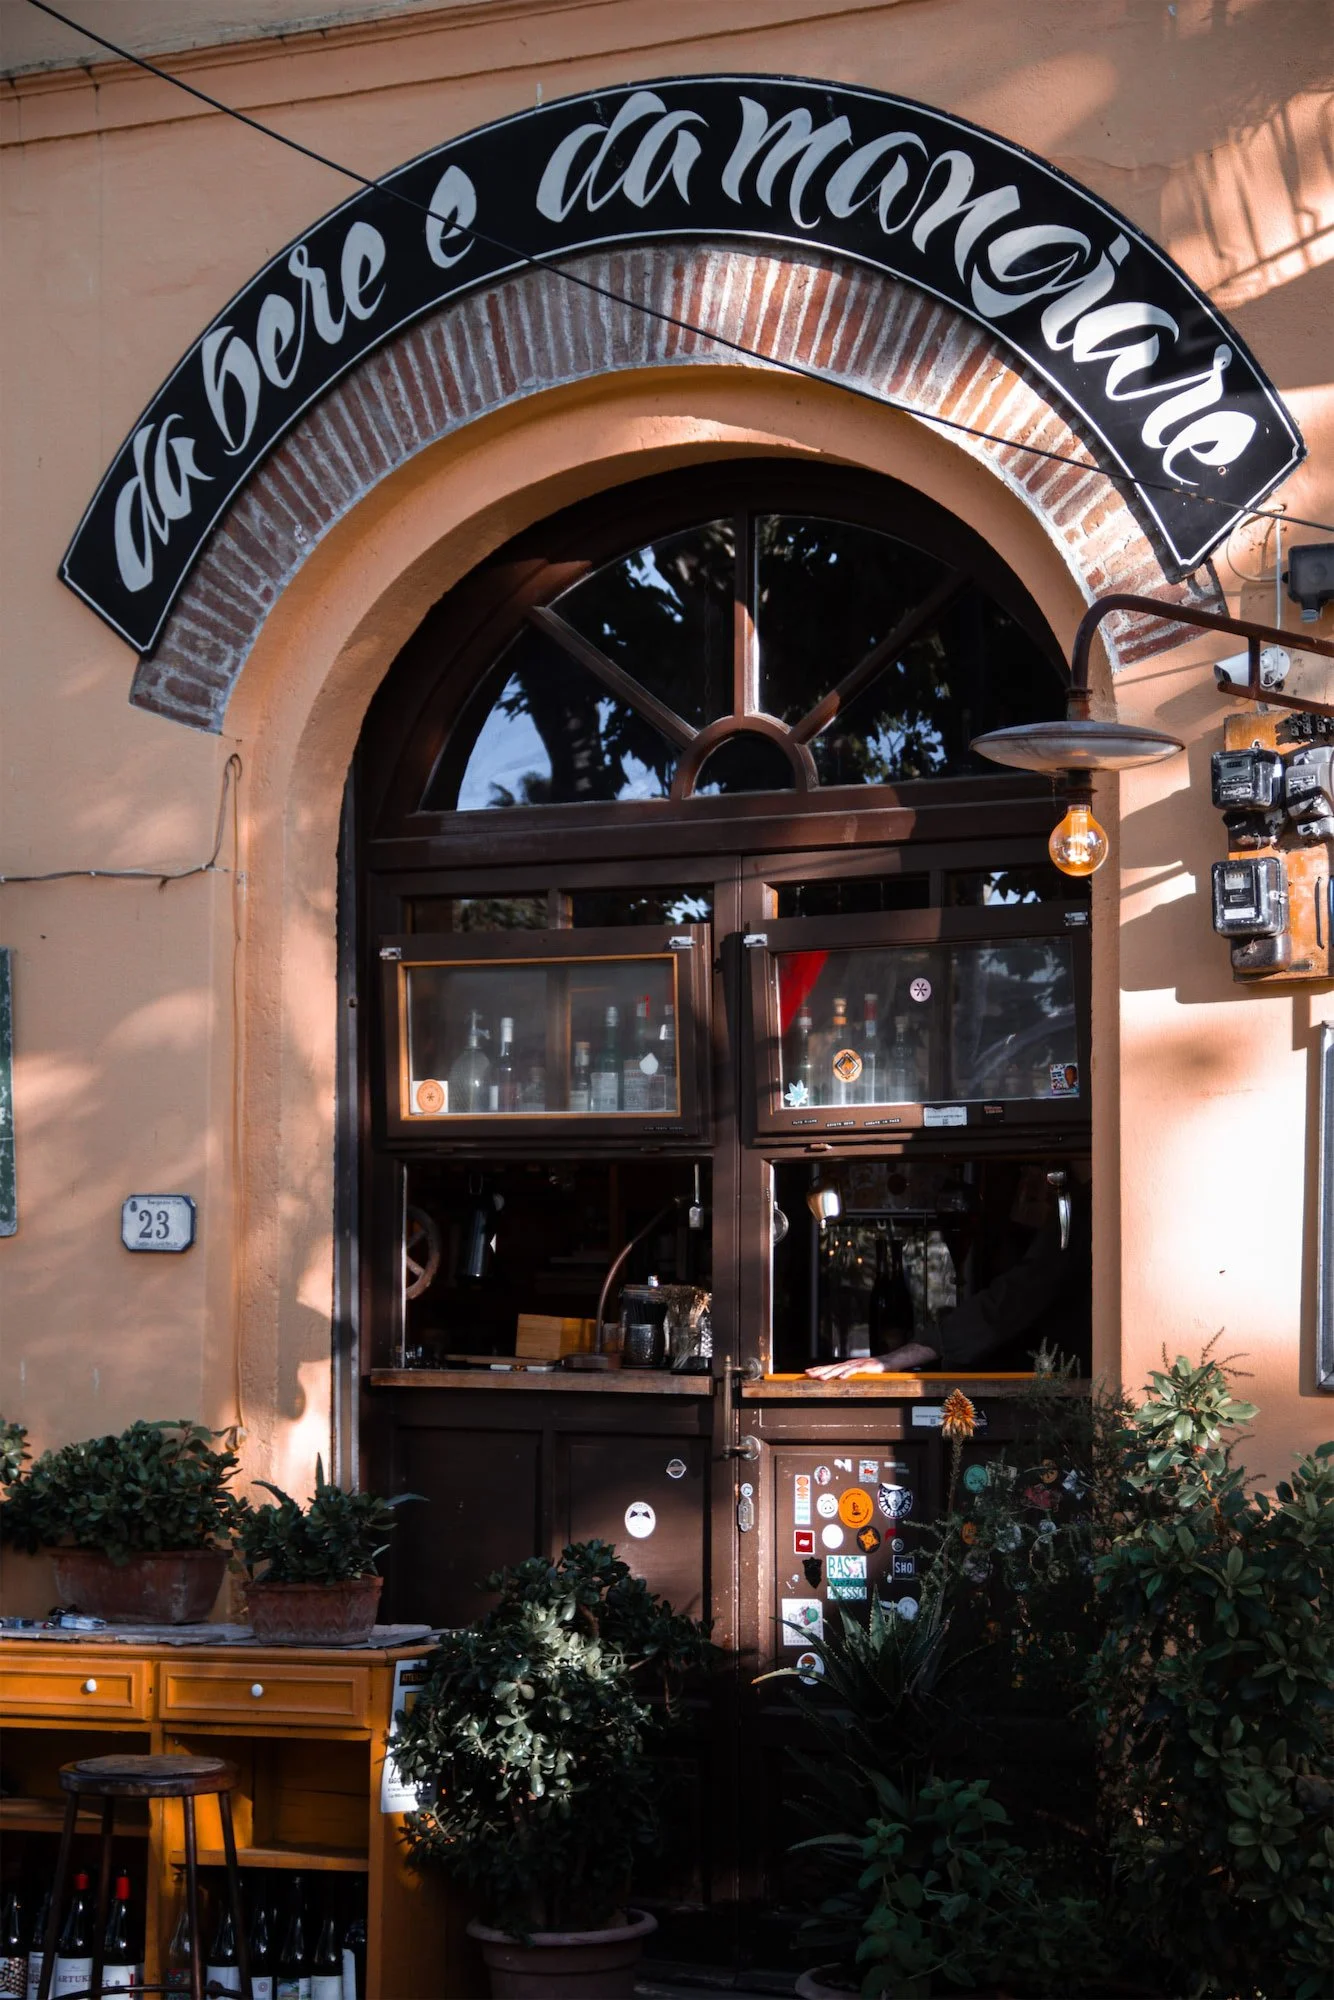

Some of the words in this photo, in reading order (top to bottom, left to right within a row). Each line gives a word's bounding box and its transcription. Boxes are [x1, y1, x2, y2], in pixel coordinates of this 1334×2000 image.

[114, 413, 214, 593] da
[201, 221, 387, 456] bere
[425, 164, 477, 269] e
[535, 90, 709, 222] da
[721, 95, 1258, 486] mangiare
[138, 1209, 170, 1240] 23
